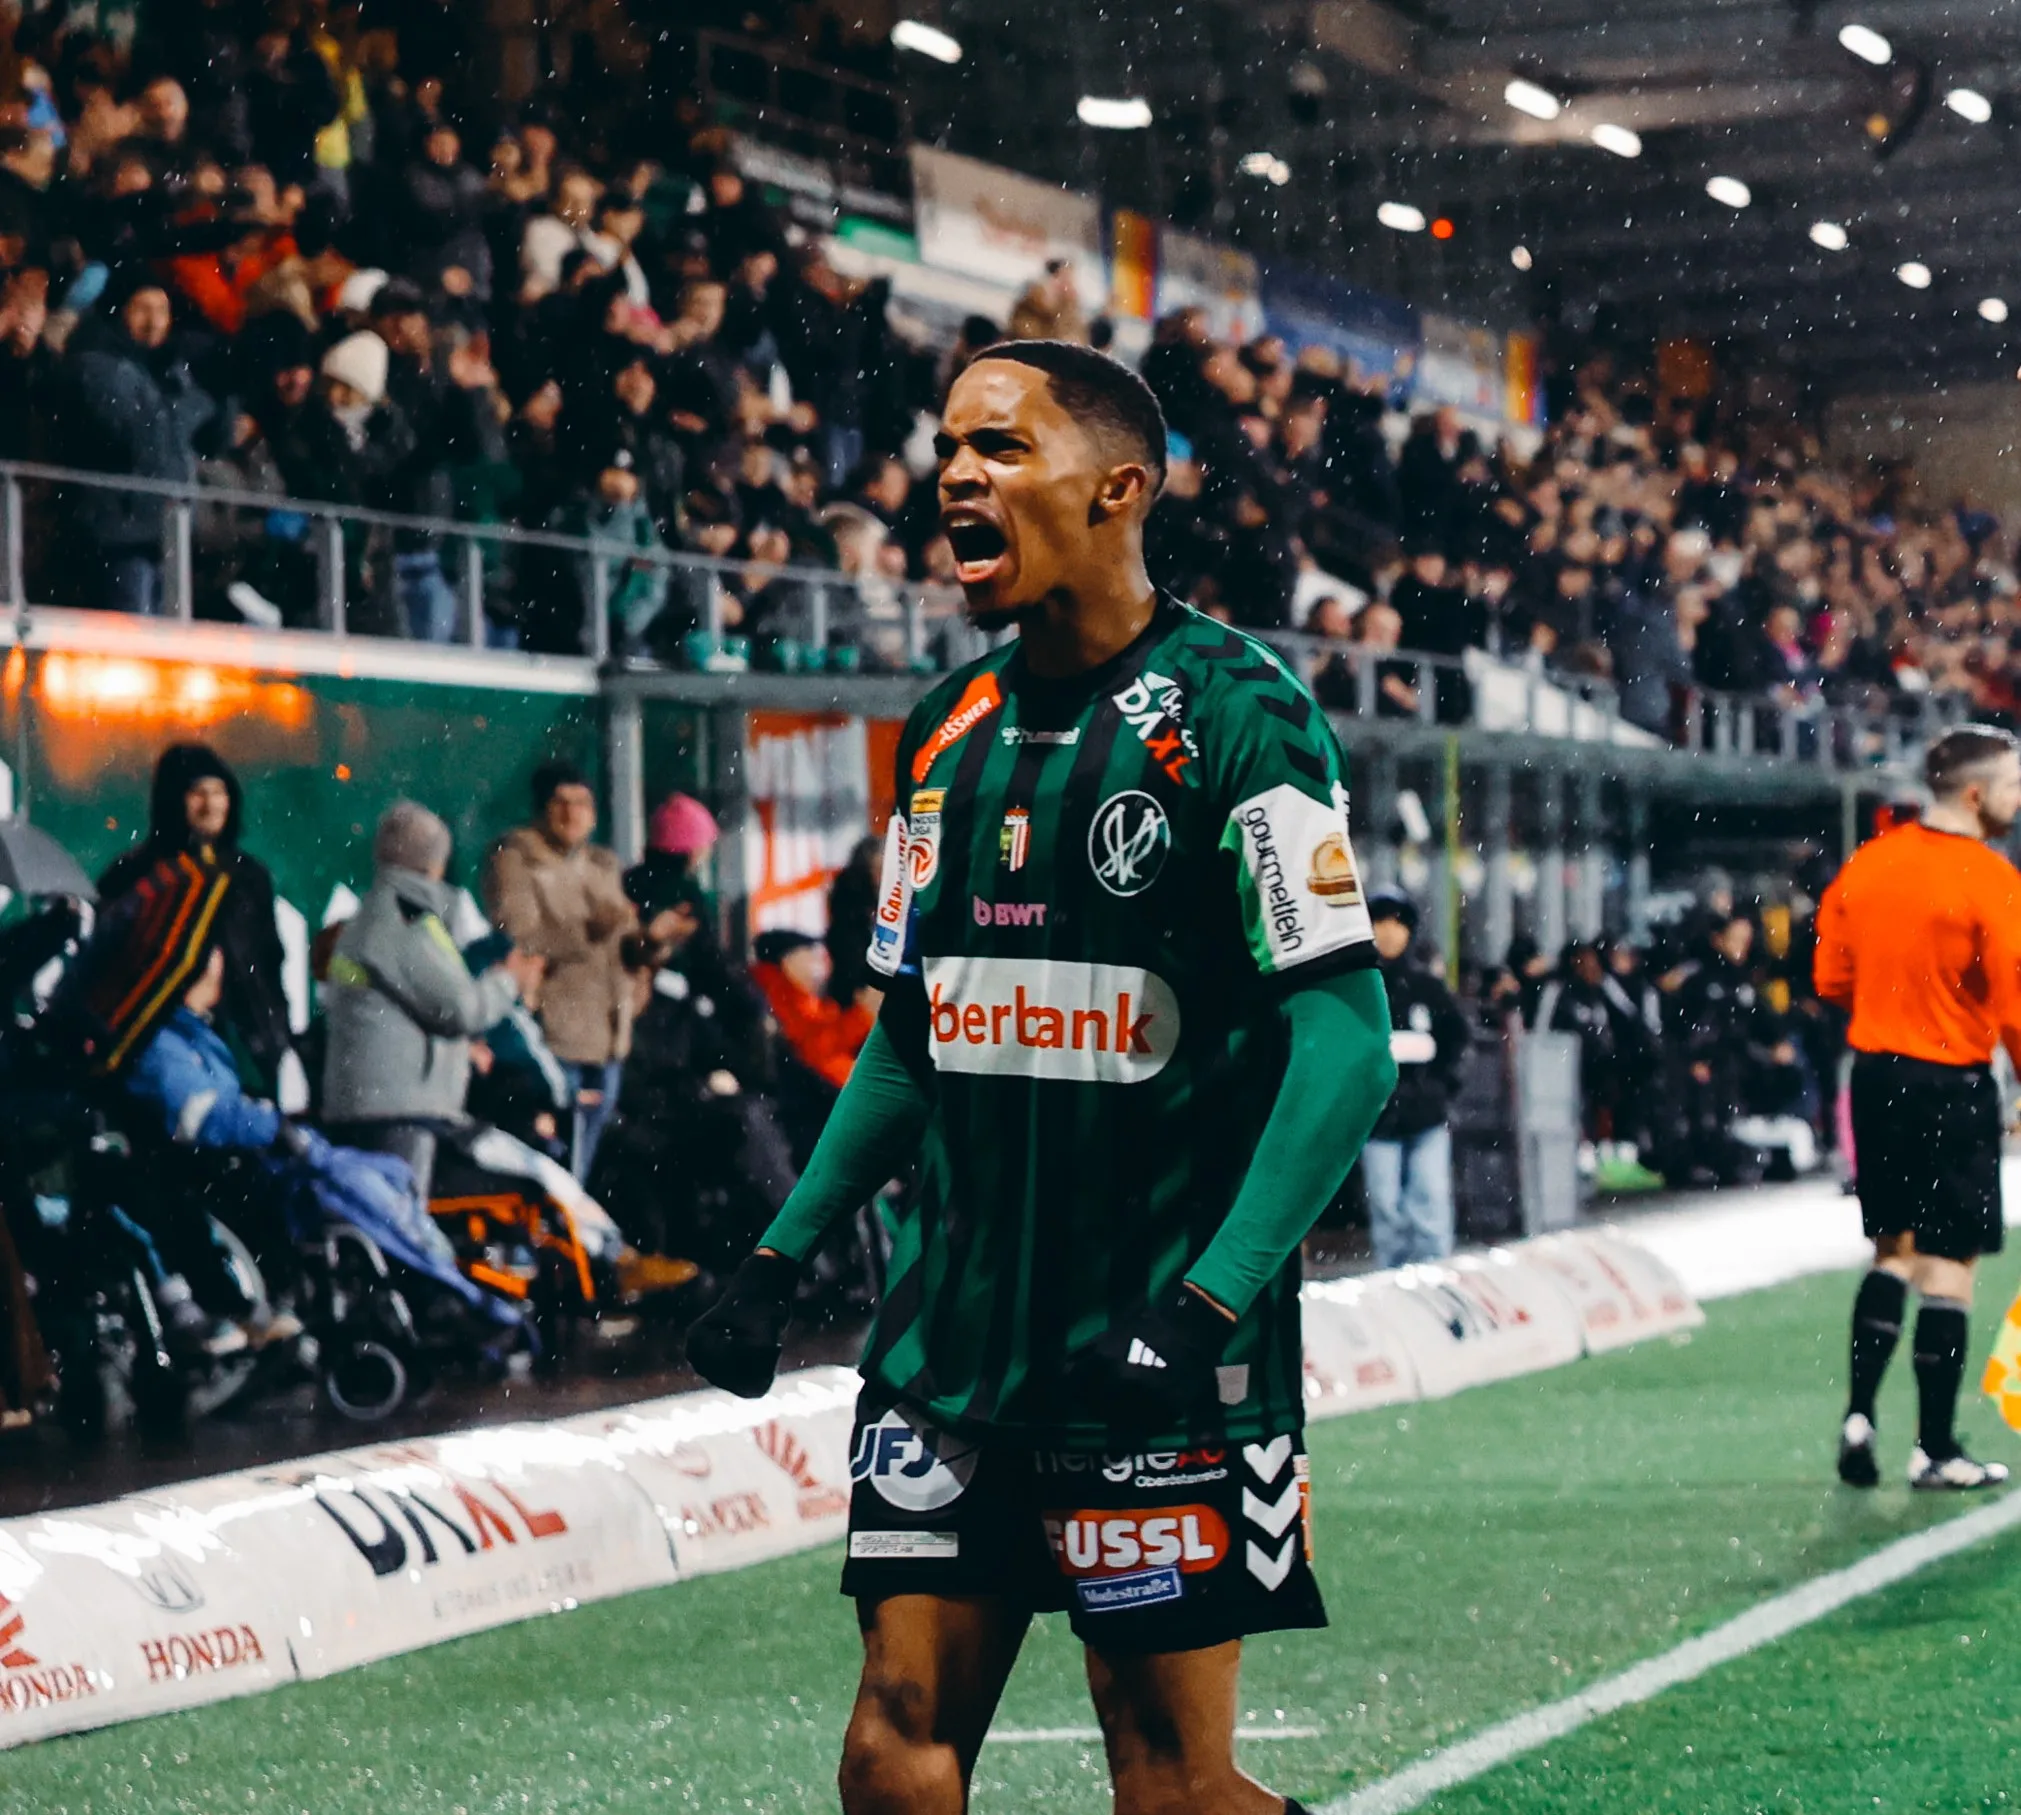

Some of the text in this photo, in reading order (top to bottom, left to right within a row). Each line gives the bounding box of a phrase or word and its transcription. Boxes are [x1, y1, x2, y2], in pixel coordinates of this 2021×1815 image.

[1239, 806, 1305, 953] gourmetfein
[994, 903, 1047, 926] BWT
[139, 1621, 267, 1686] HONDA
